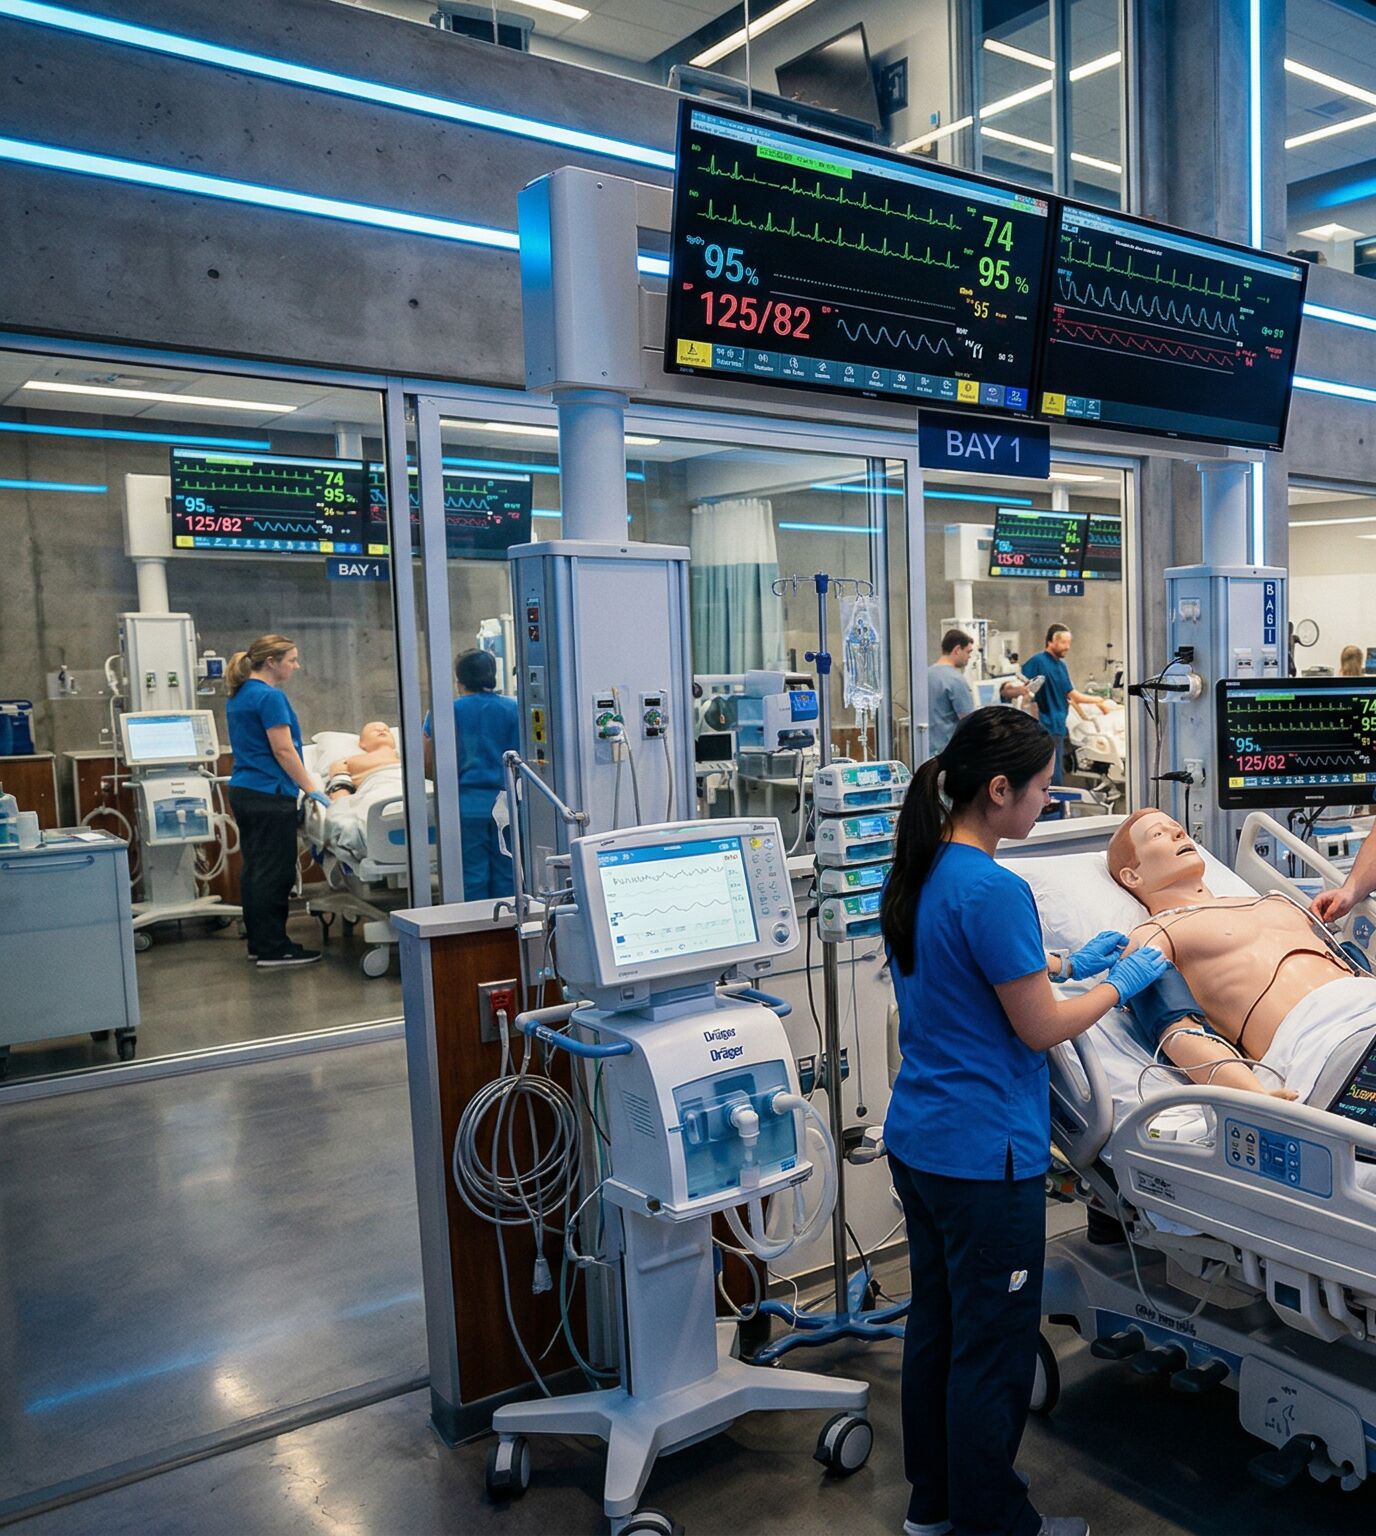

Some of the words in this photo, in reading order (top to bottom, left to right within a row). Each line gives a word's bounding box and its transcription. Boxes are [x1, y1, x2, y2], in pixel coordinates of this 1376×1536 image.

[982, 215, 1014, 252] 74
[978, 256, 1010, 290] 95
[700, 291, 811, 339] 125/82
[946, 429, 1002, 460] BAY
[1010, 437, 1020, 463] 1
[323, 471, 344, 486] 74
[324, 488, 345, 503] 95
[185, 516, 242, 532] 125/82
[338, 563, 369, 577] BAY
[372, 565, 380, 577] 1
[1236, 754, 1286, 772] 125/82
